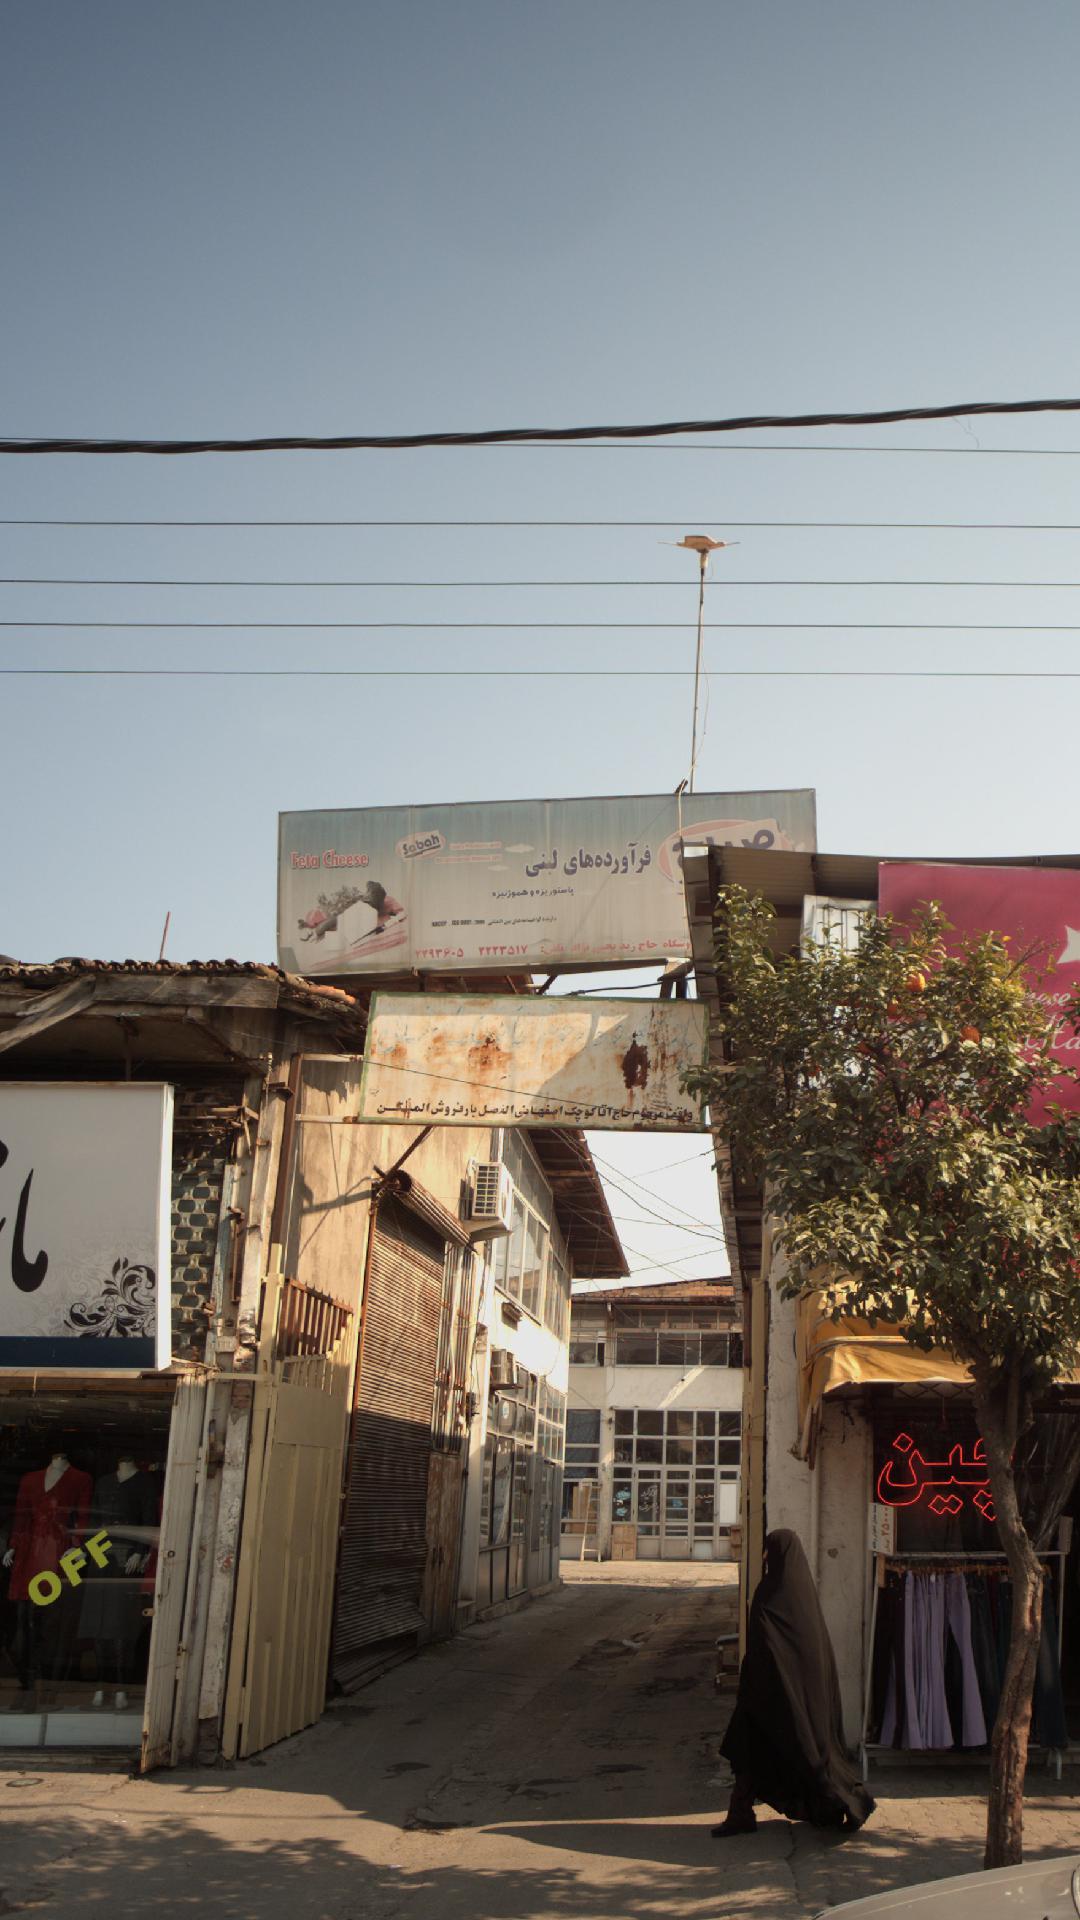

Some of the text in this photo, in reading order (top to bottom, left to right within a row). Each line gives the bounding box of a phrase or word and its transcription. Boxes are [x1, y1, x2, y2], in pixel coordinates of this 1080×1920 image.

[291, 848, 369, 869] Feta Cheese
[402, 834, 441, 857] Sabah
[525, 848, 558, 877] لبنی
[28, 1530, 113, 1606] OFF
